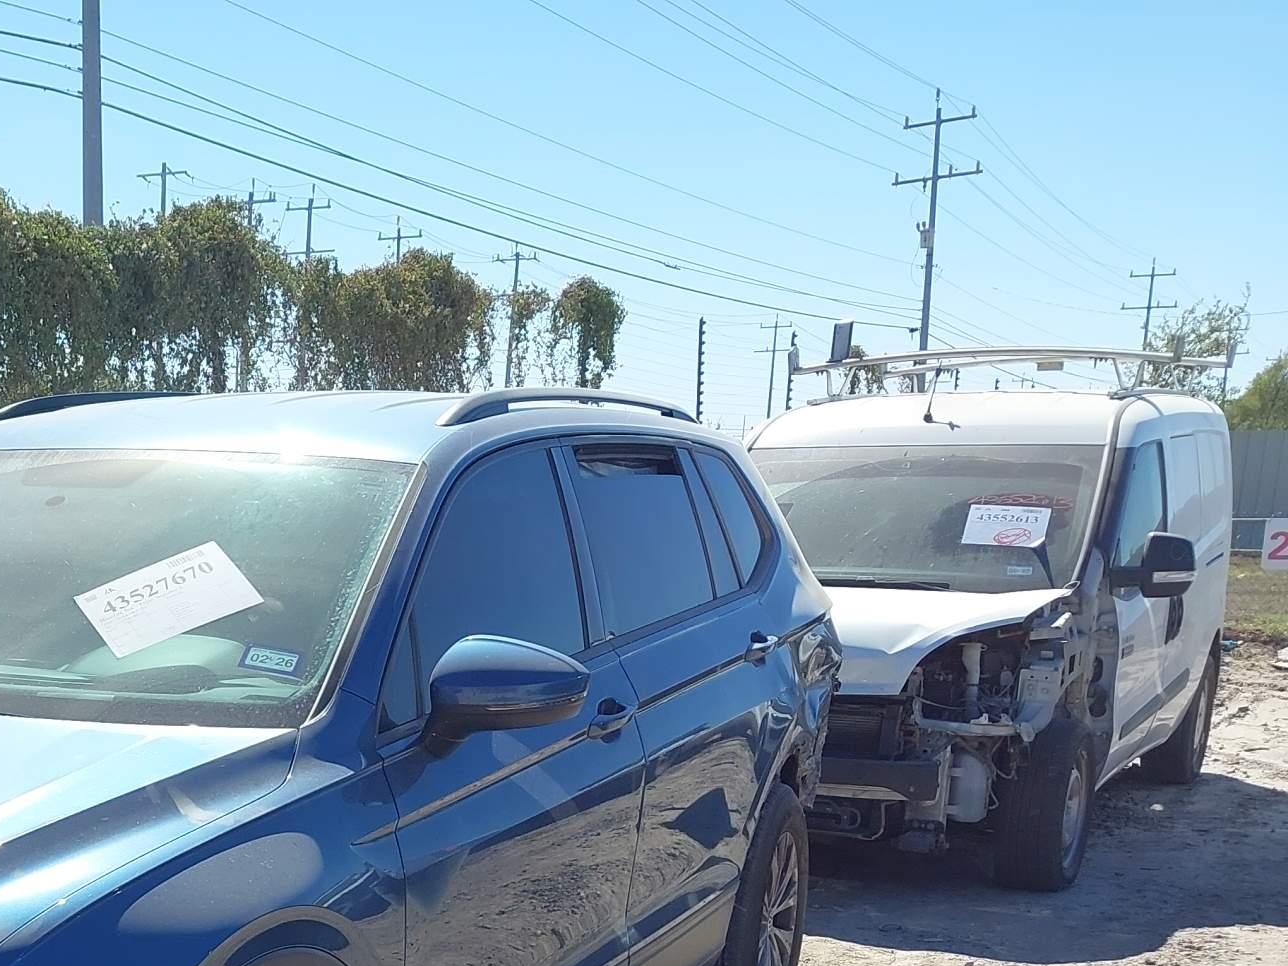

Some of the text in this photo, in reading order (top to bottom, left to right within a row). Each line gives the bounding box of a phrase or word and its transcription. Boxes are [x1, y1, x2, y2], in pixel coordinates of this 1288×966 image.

[976, 513, 1040, 524] 43552613
[103, 561, 214, 614] 43527670
[275, 657, 294, 668] 26
